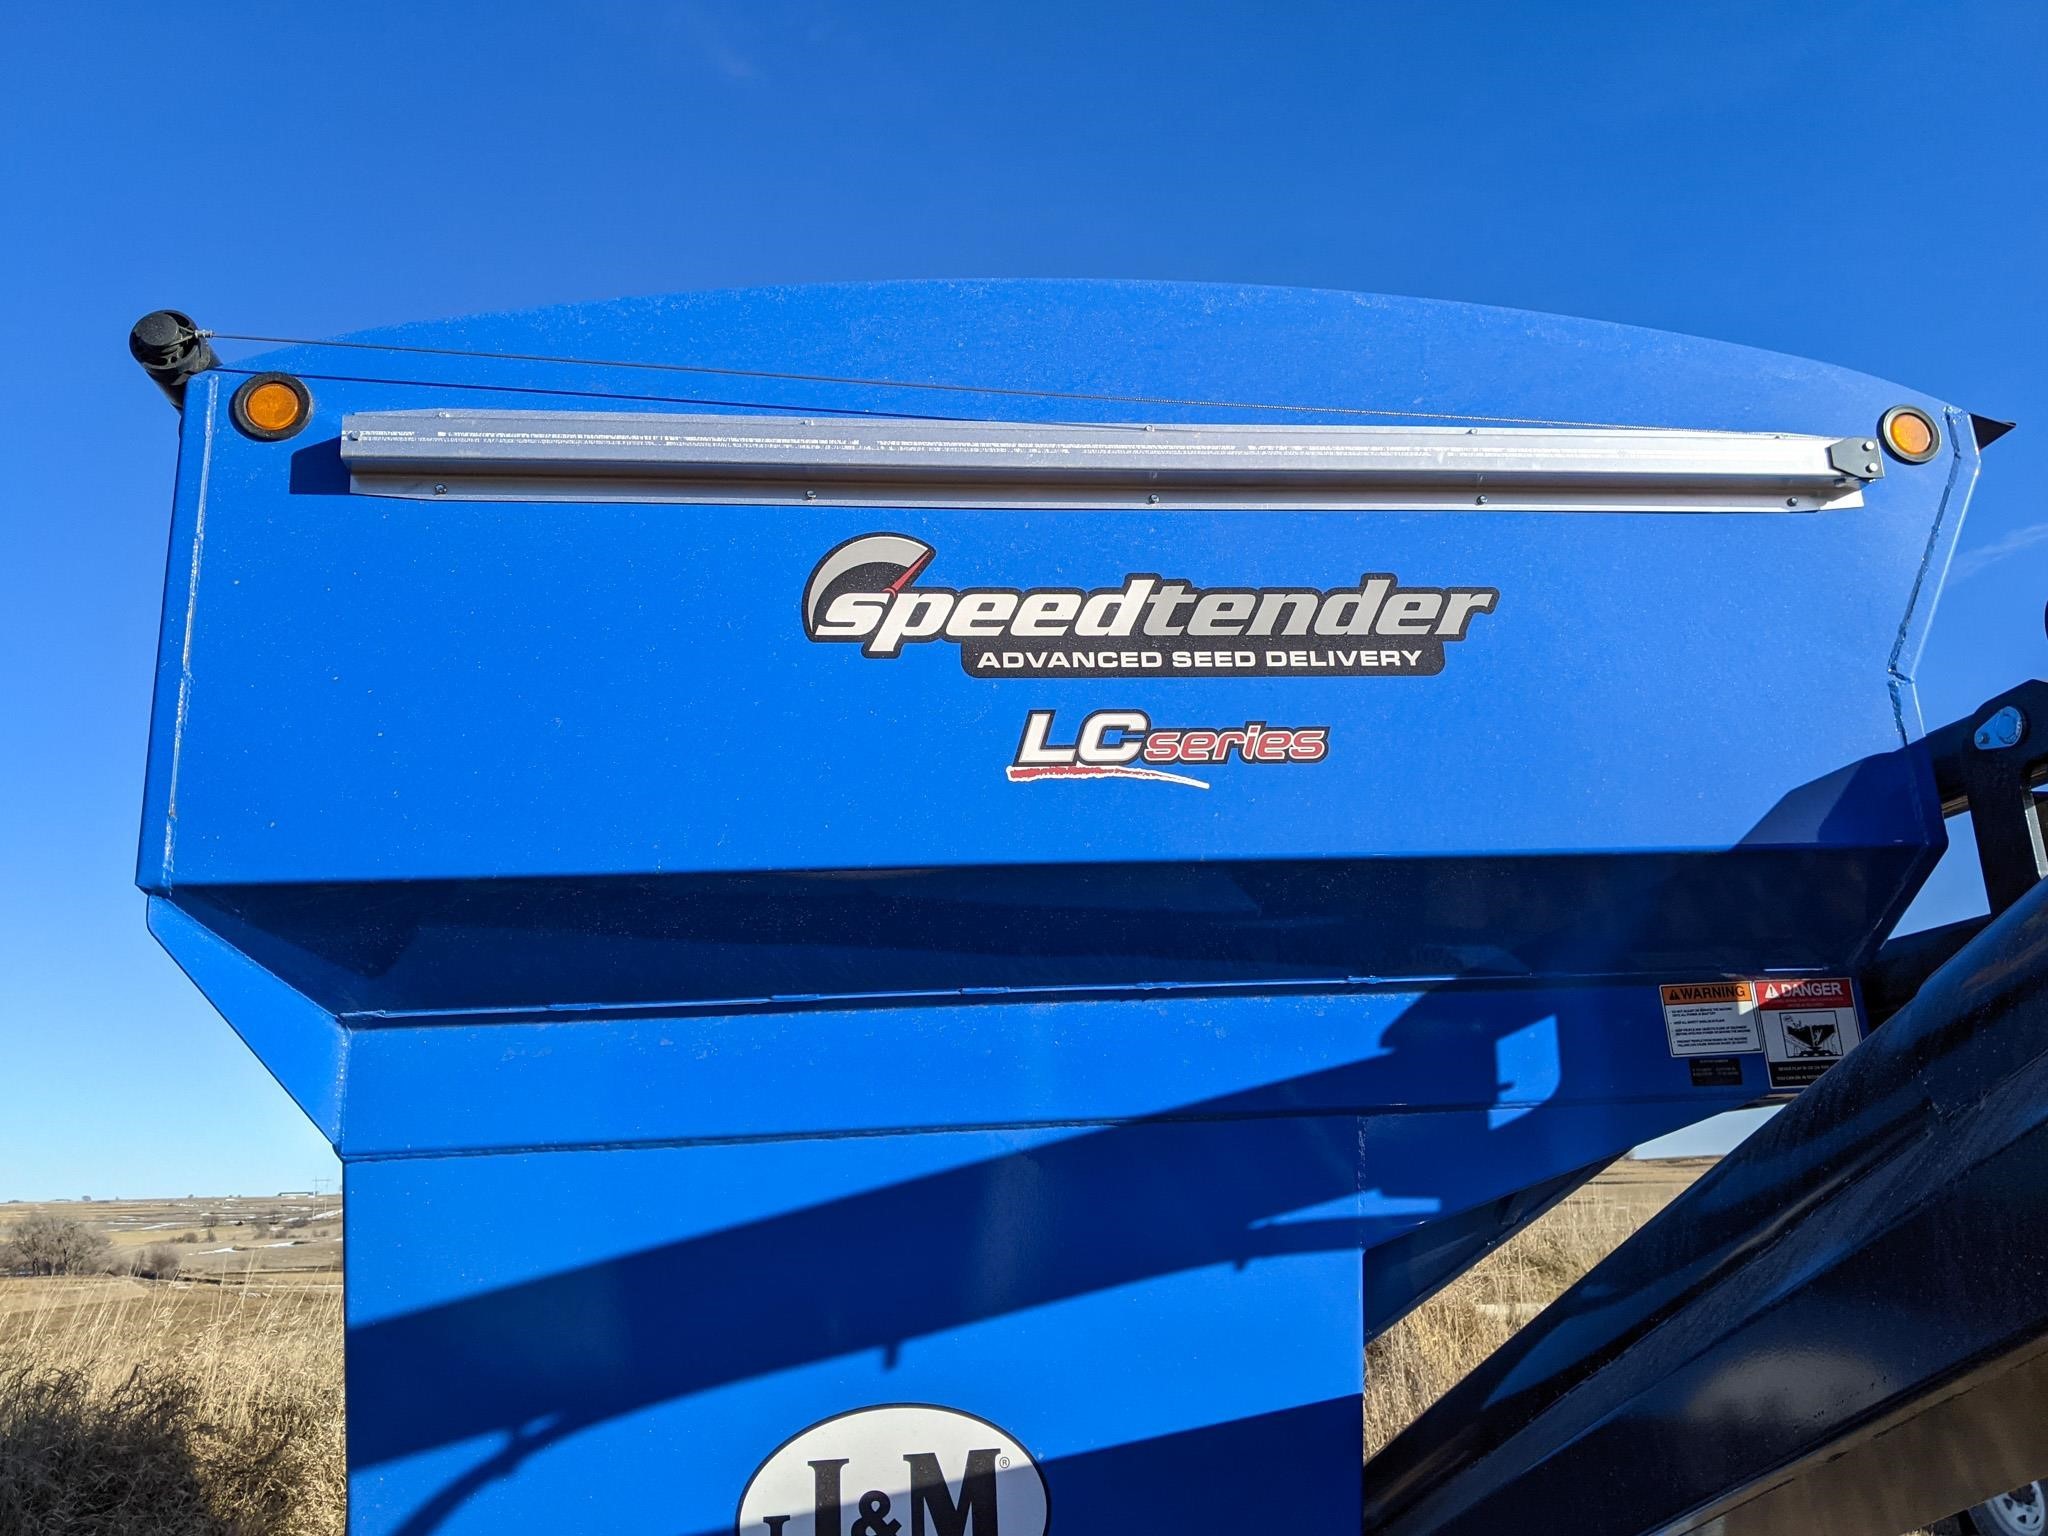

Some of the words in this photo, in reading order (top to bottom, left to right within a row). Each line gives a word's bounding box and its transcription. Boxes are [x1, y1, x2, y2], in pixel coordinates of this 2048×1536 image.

[976, 650, 1163, 669] ADVANCED
[1171, 650, 1256, 668] SEED
[1265, 650, 1423, 668] DELIVERY
[1680, 985, 1746, 1001] WARNING
[1780, 982, 1844, 997] DANGER
